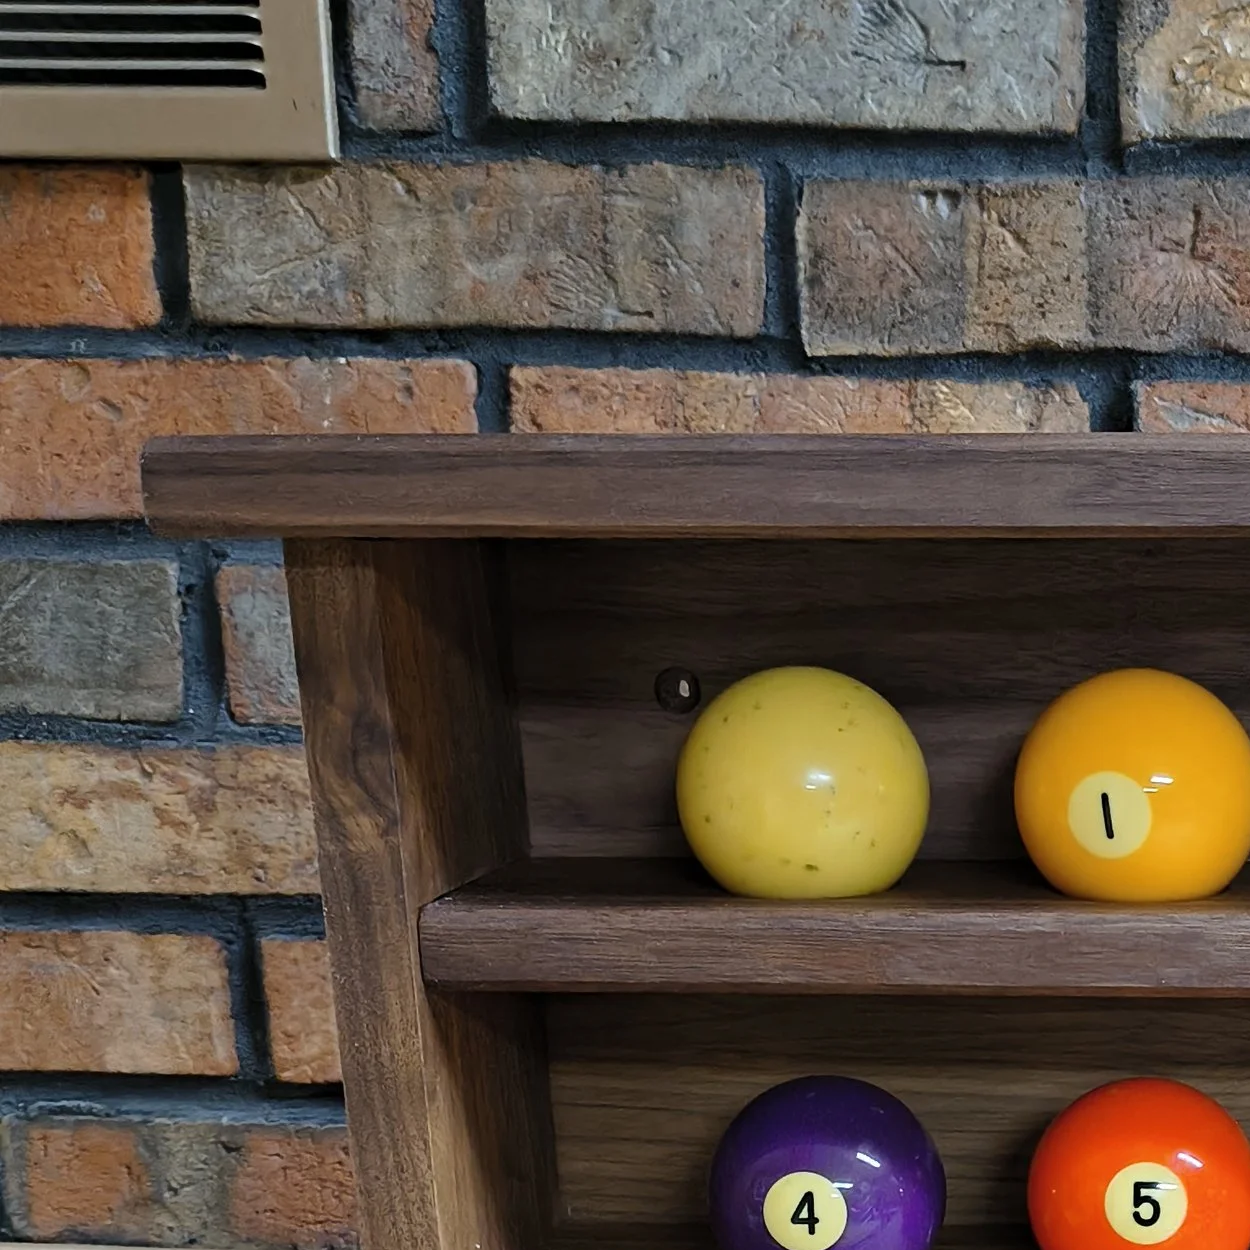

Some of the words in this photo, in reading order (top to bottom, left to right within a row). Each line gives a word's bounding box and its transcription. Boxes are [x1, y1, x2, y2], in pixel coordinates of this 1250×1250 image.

[1100, 792, 1115, 840] 1
[790, 1190, 820, 1236] 4
[1132, 1181, 1161, 1227] 5
